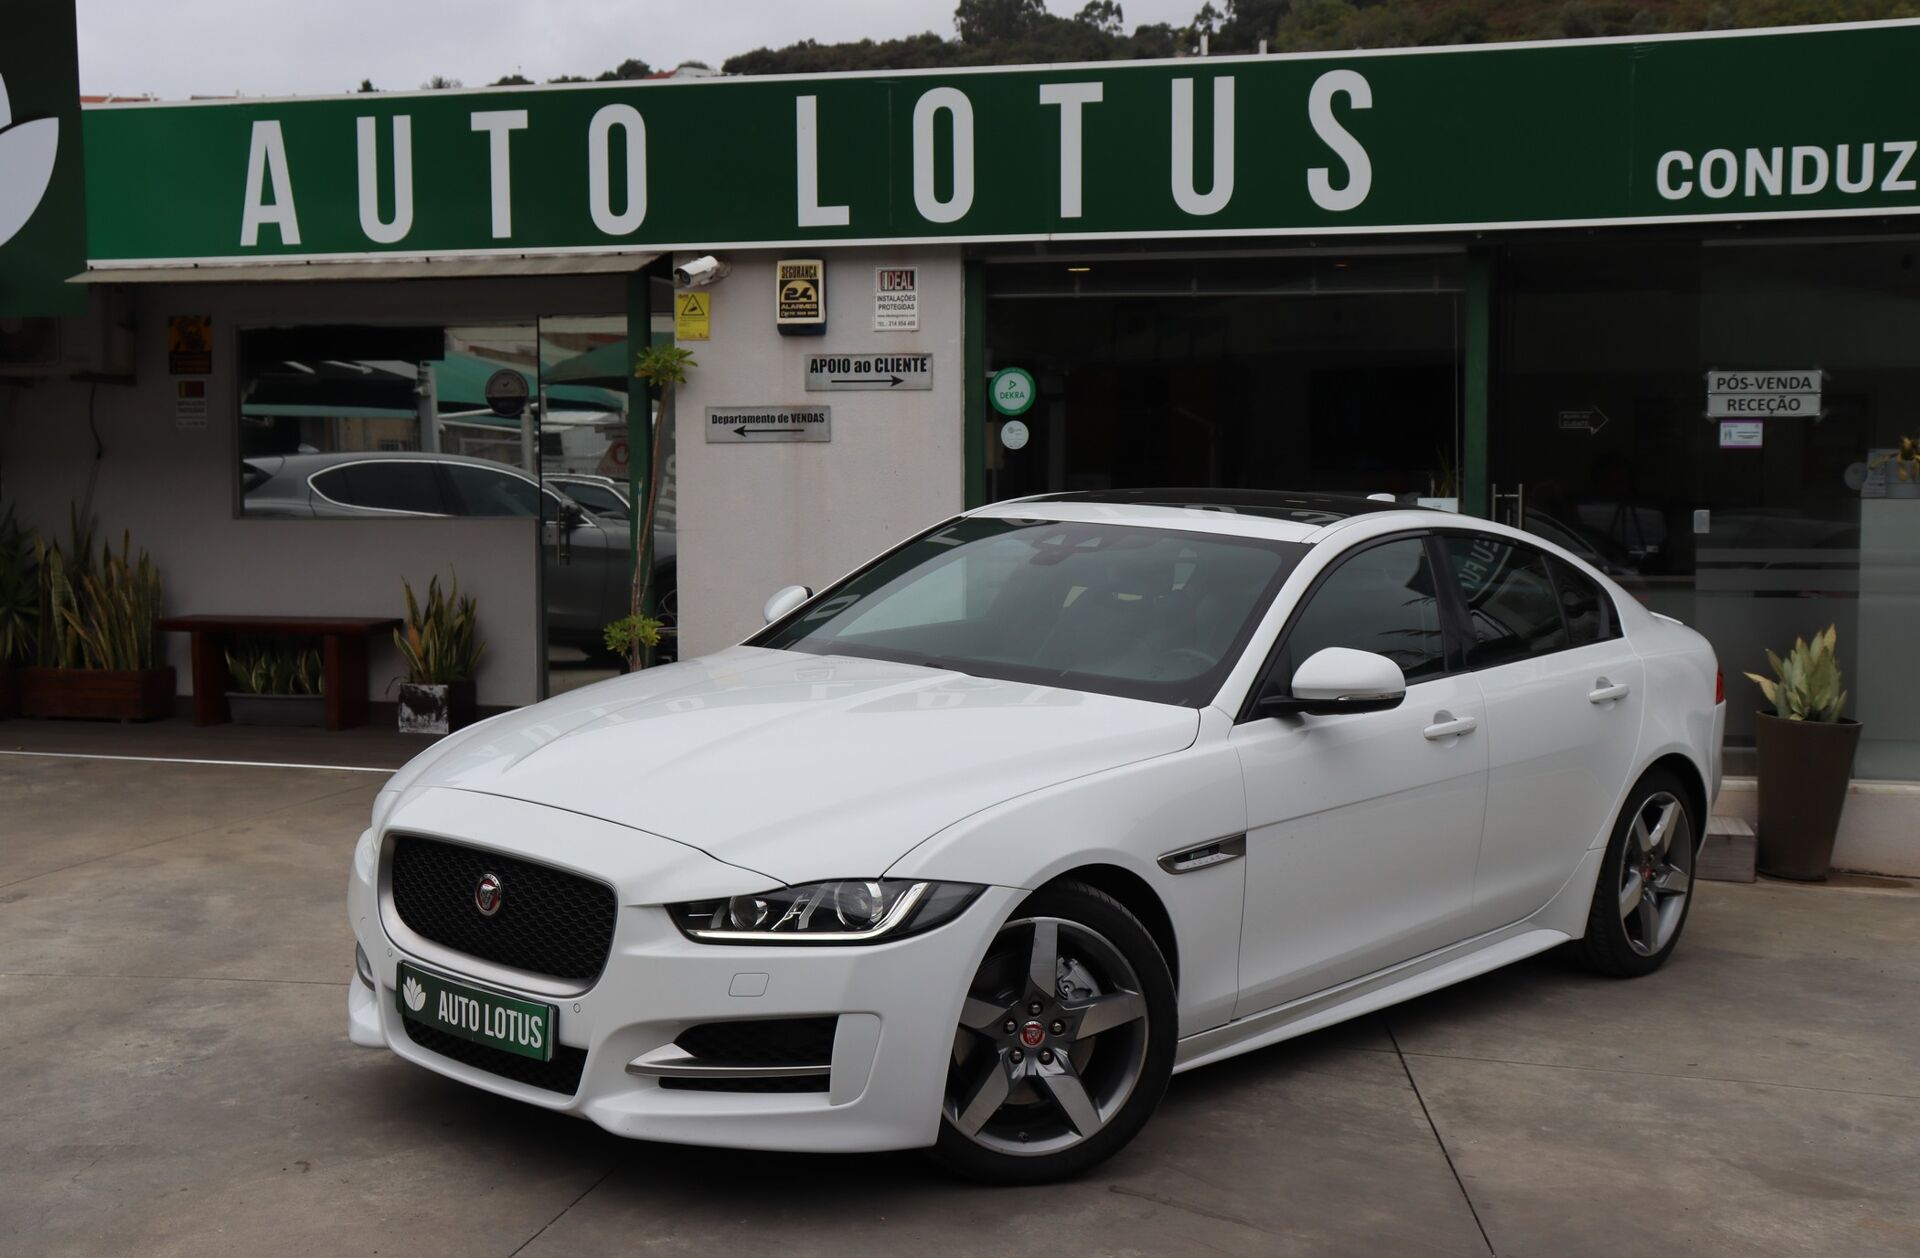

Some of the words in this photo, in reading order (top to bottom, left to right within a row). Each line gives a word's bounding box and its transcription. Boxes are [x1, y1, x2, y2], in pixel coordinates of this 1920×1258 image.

[240, 103, 648, 246] AUTO
[796, 69, 1373, 227] LOTUS
[1656, 140, 1918, 200] CONDUZ
[784, 287, 812, 300] 24
[878, 303, 914, 311] PROTEGIDAS
[810, 358, 851, 374] APOIO
[854, 359, 872, 373] ao
[874, 357, 927, 373] CLIENTE
[1716, 374, 1812, 390] PÓS-VENDA
[1000, 391, 1025, 400] DEKRA
[1727, 395, 1801, 414] RECEÇÃO
[711, 413, 776, 425] Departamento
[777, 413, 789, 424] de
[790, 412, 825, 424] VENDAS
[438, 990, 480, 1032] AUTO
[484, 1003, 543, 1049] LOTUS
